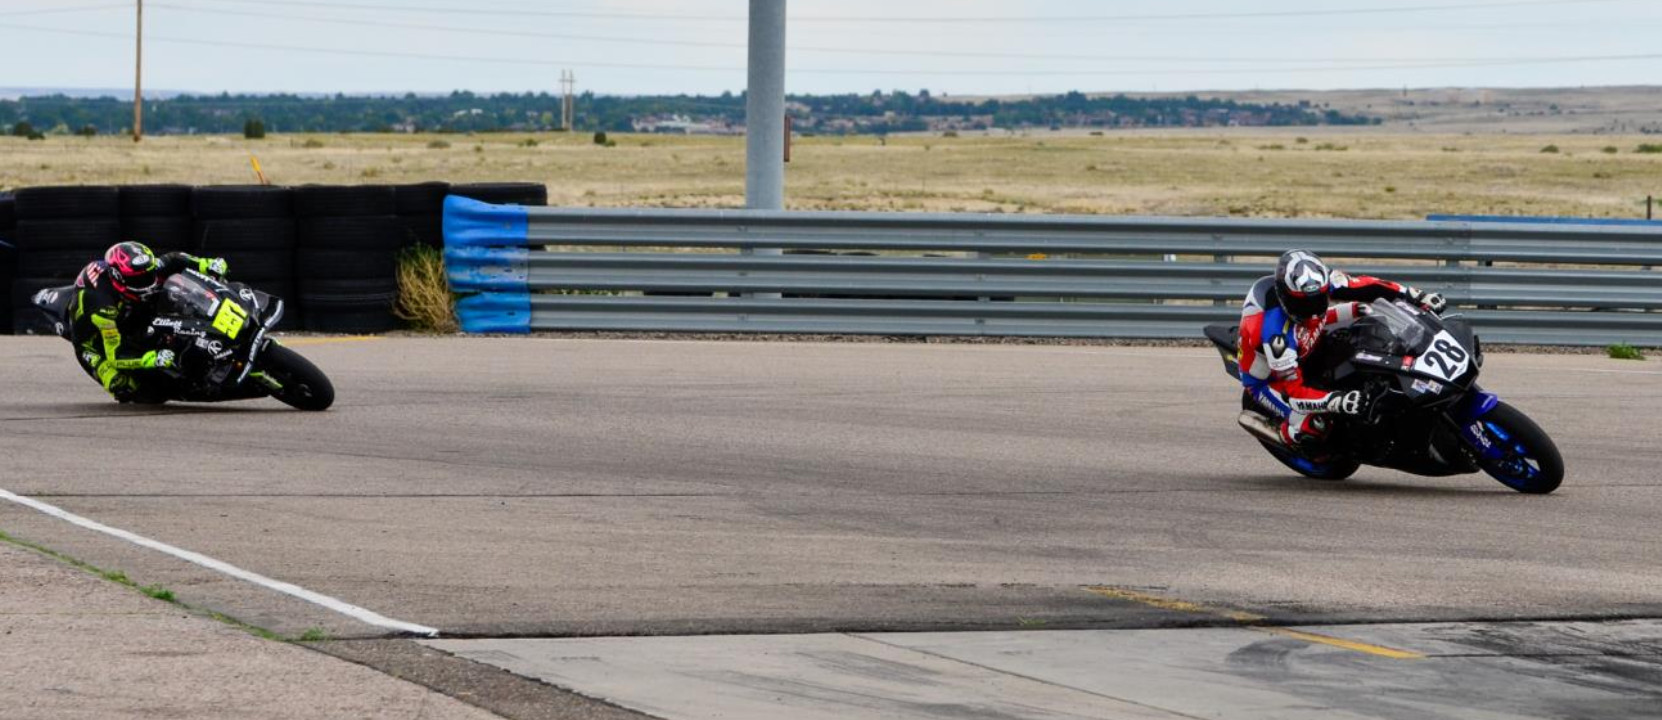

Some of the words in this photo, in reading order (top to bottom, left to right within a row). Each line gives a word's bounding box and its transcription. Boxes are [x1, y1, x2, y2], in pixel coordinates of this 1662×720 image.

[152, 317, 182, 327] Elliott
[173, 326, 206, 338] Racing
[1424, 339, 1466, 380] 28
